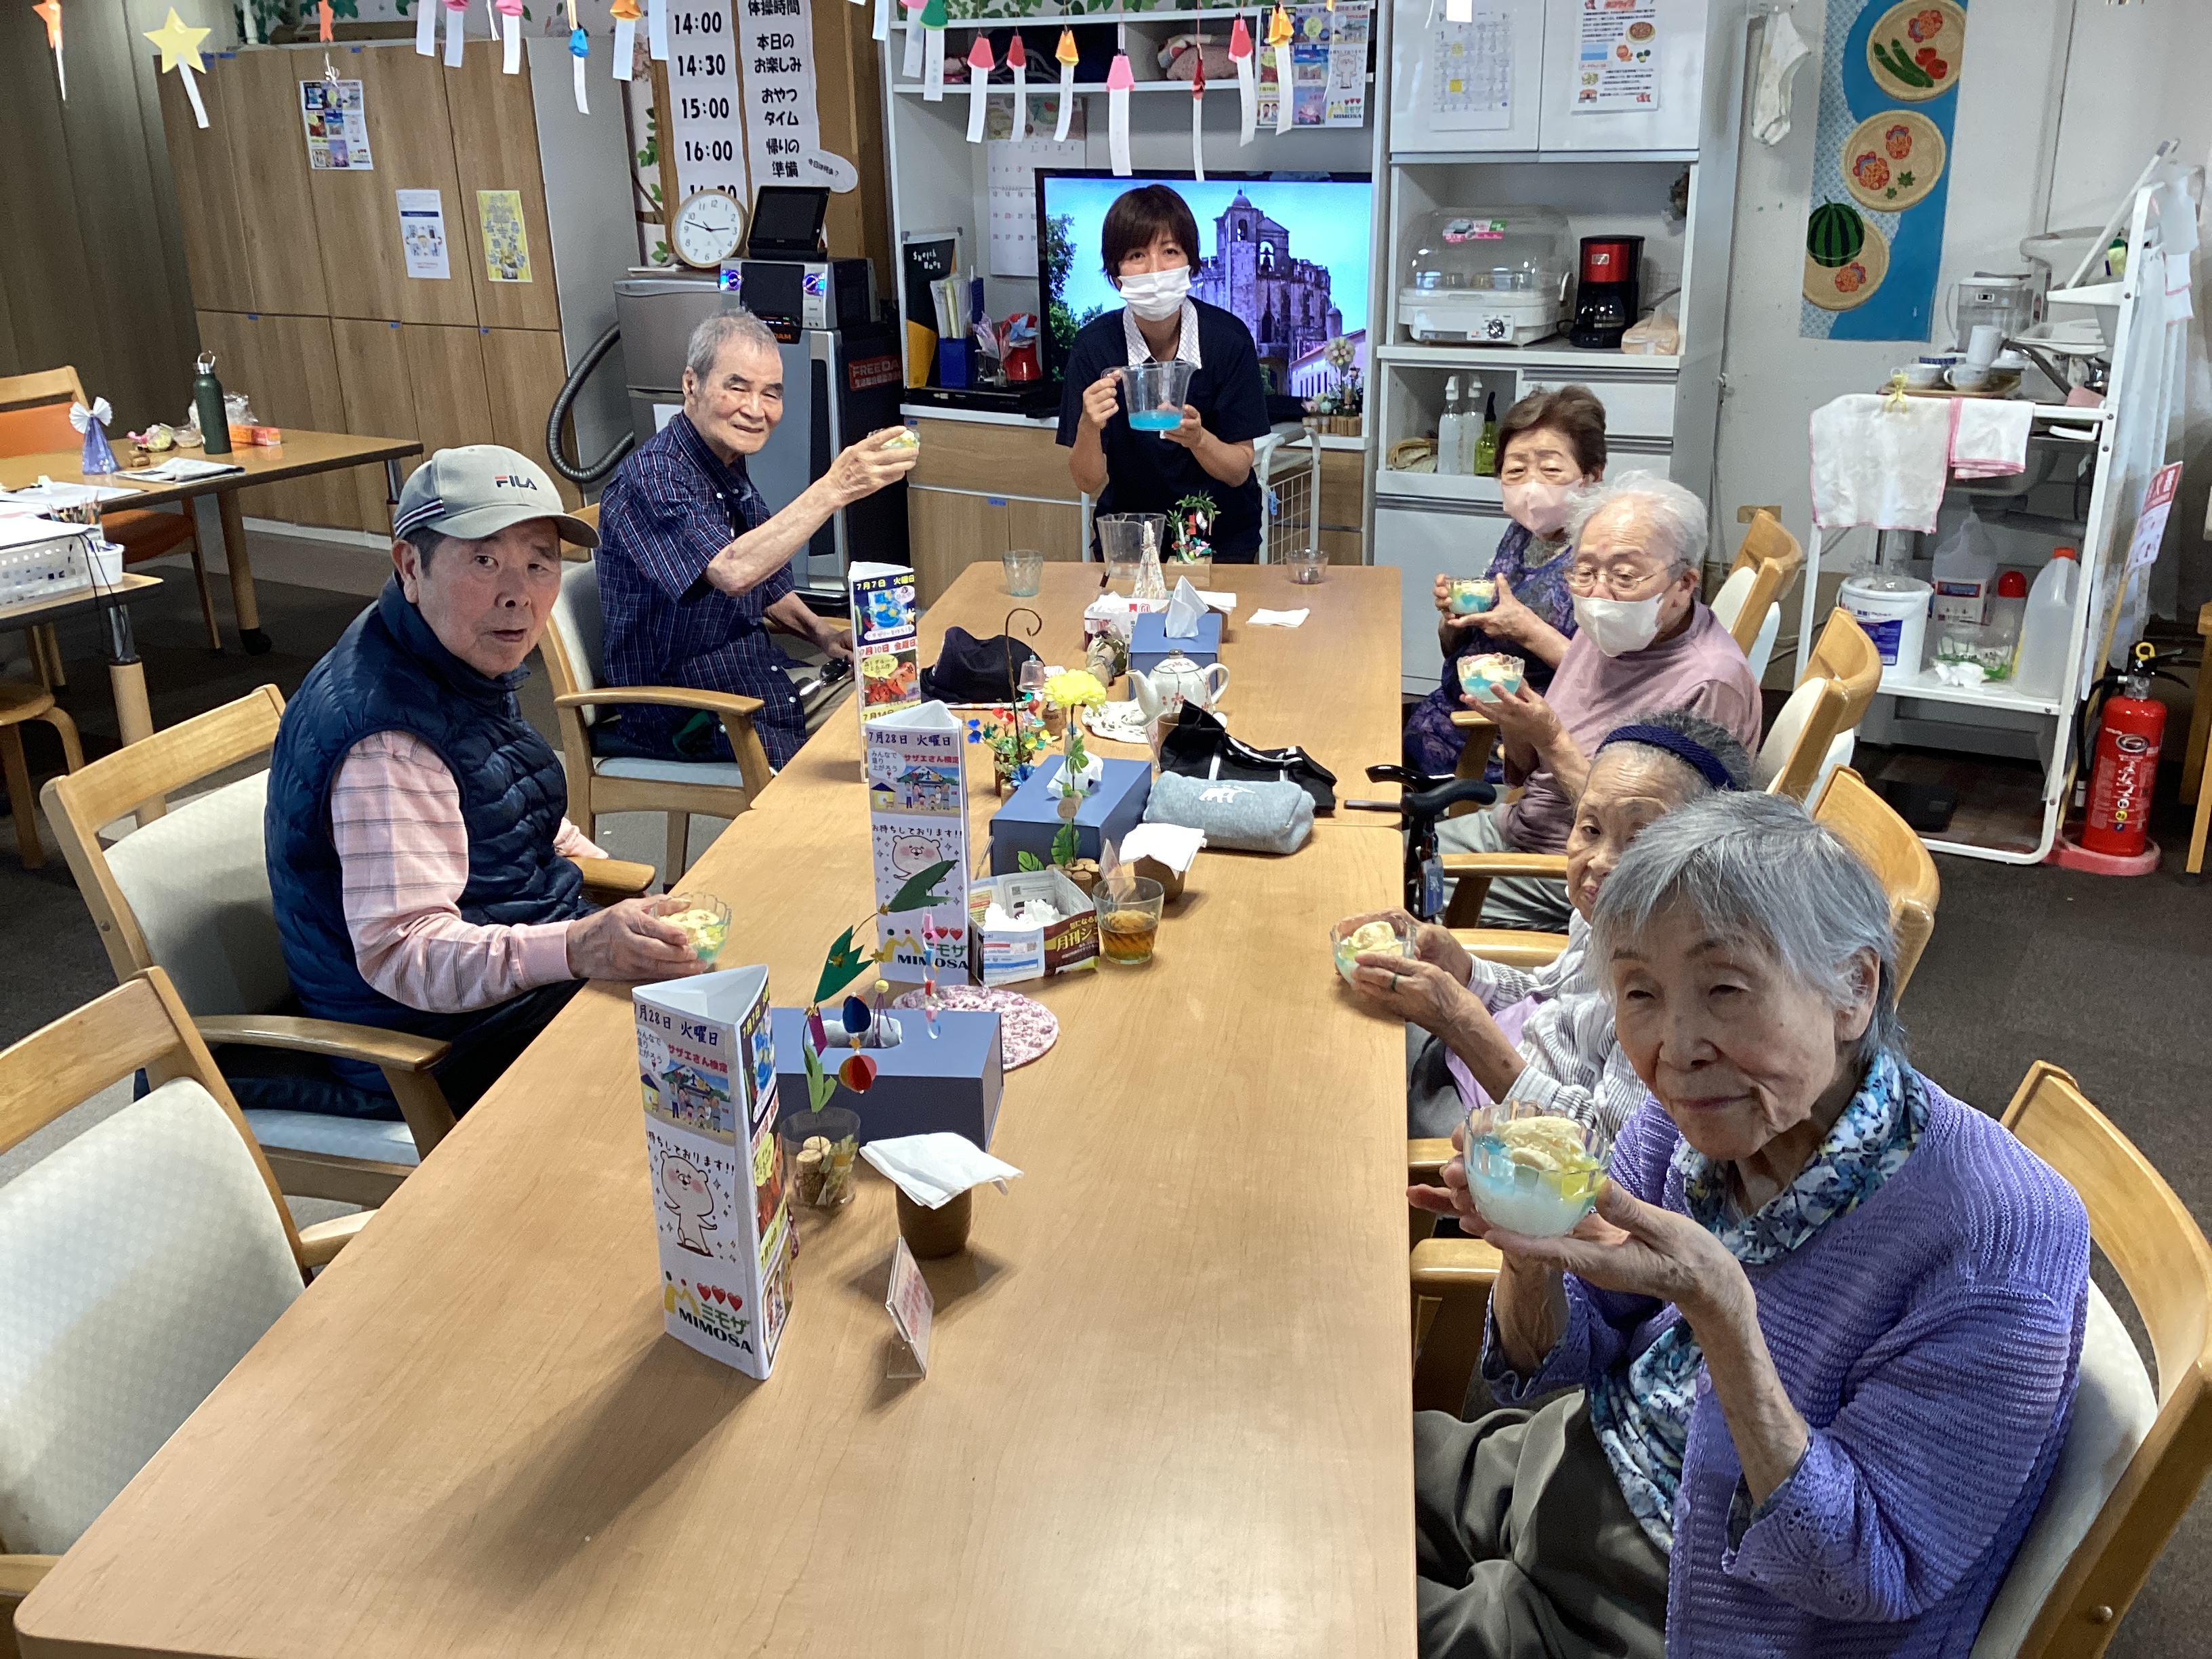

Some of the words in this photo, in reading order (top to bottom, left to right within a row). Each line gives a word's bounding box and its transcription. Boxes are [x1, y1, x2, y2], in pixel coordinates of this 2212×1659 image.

[675, 12, 722, 34] 14:00
[756, 33, 794, 50] 本日の
[678, 54, 726, 76] 14:30
[754, 57, 802, 73] お楽しみ
[762, 87, 798, 103] おやつ
[682, 98, 729, 119] 15:00
[764, 111, 799, 126] タイム
[685, 140, 732, 161] 16:00
[766, 138, 800, 155] 帰りの
[772, 161, 798, 178] 準備
[698, 203, 705, 211] 11
[710, 199, 718, 208] 12
[724, 203, 728, 211] 1
[688, 212, 695, 220] 10
[731, 213, 736, 222] 2
[732, 227, 737, 235] 3
[685, 239, 691, 247] 8
[717, 249, 722, 258] 5
[495, 475, 537, 491] FILA
[856, 579, 886, 590] 7月7日
[859, 643, 889, 656] 7月10日
[895, 638, 916, 651] 金曜日
[869, 731, 907, 744] 7月28日
[917, 734, 951, 746] 火曜日
[872, 750, 897, 758] みんなで
[904, 754, 959, 764] サザエさん検定
[926, 943, 967, 958] モザ
[681, 1021, 718, 1046] 火曜日
[668, 1044, 728, 1073] サザエさん検定
[647, 1130, 735, 1176] 持ちしております!!
[701, 1302, 751, 1335] ミモザ
[679, 1307, 754, 1354] MIMOSA
